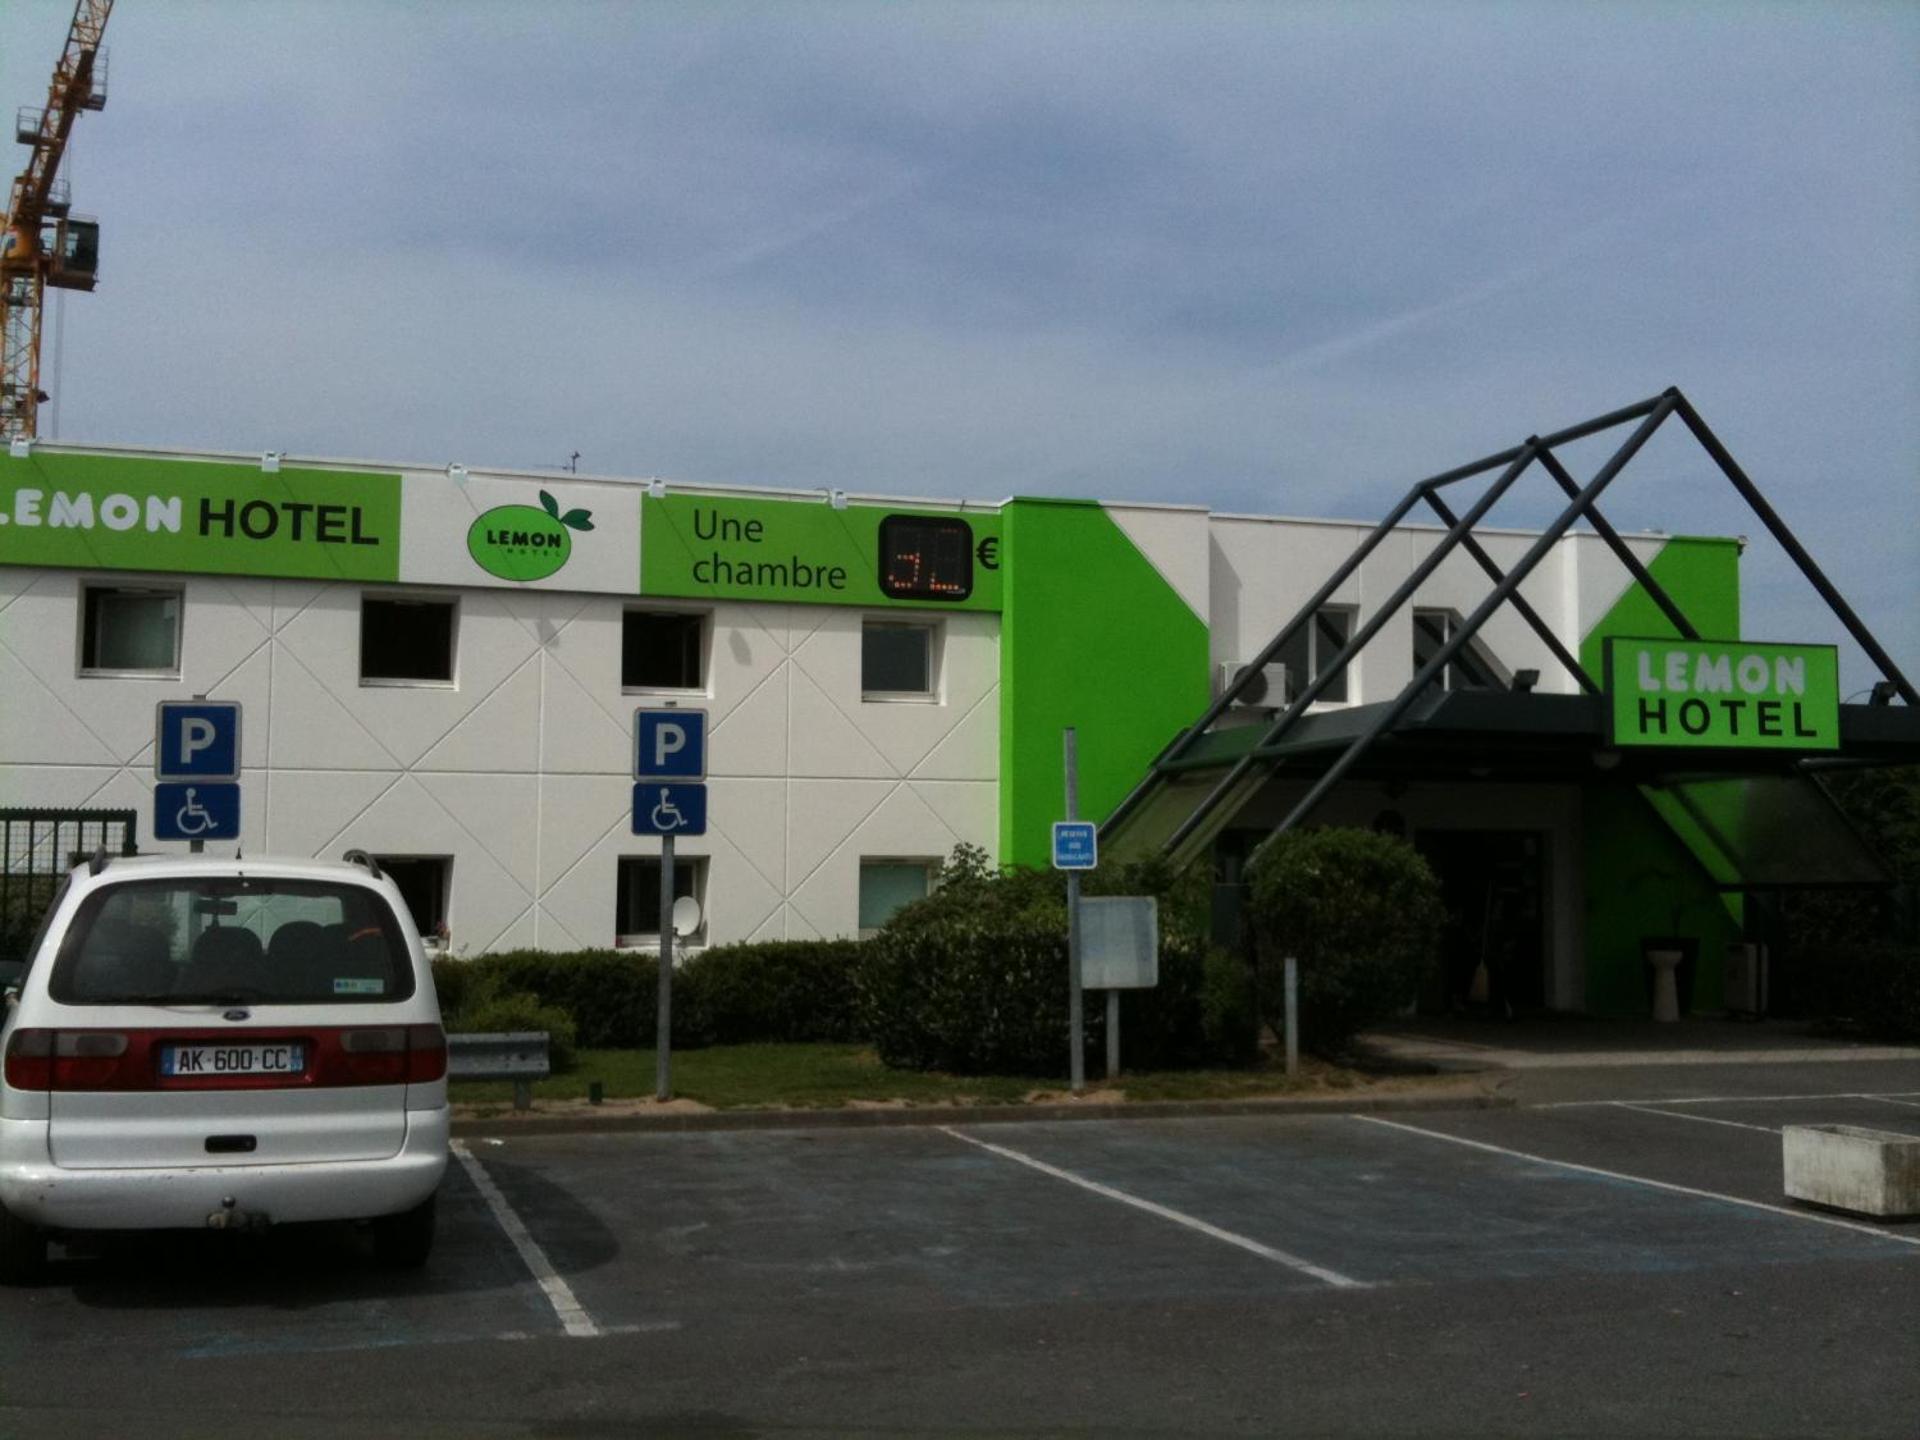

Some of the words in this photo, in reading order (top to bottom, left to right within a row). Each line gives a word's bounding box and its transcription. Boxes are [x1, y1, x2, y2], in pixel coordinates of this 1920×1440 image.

[0, 489, 181, 532] EMON
[200, 498, 379, 545] HOTEL
[694, 508, 763, 542] Une
[487, 530, 562, 548] LEMON
[693, 553, 846, 589] chambre
[1639, 652, 1804, 695] LEMON
[1639, 698, 1817, 737] HOTEL
[180, 718, 215, 763] P
[656, 723, 686, 765] P
